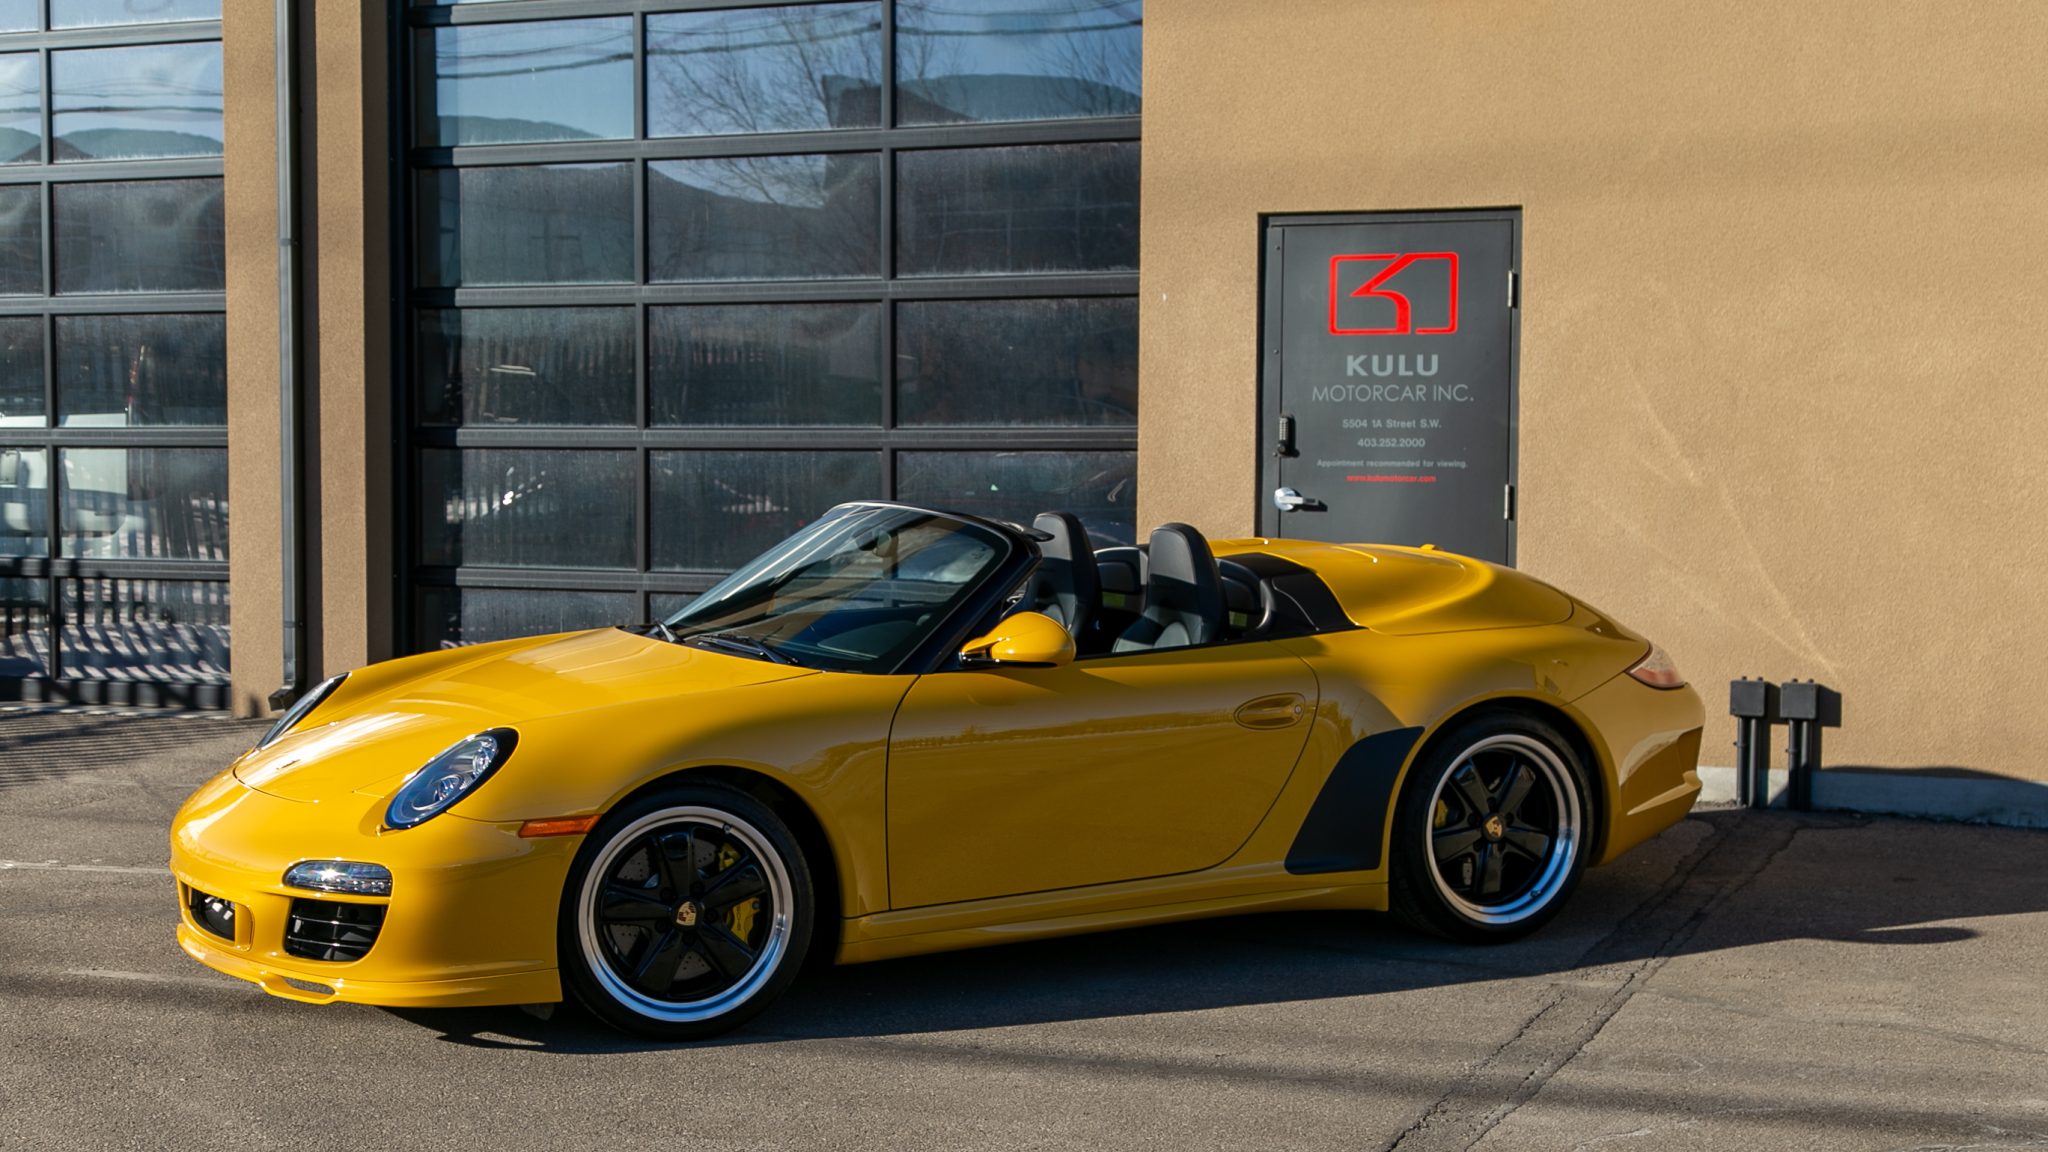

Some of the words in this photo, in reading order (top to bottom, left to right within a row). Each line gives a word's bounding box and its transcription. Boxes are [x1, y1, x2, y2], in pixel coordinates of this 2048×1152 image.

[1346, 354, 1439, 376] KULU
[1312, 384, 1426, 402] MOTORCAR
[1433, 384, 1474, 402] INC.
[1342, 418, 1367, 428] 5504
[1372, 418, 1382, 428] 1A
[1386, 418, 1416, 428] Street
[1420, 418, 1442, 428] S.W.
[1357, 438, 1426, 448] 403.252.2000
[1317, 459, 1364, 468] Appointment
[1366, 459, 1420, 467] recommended
[1423, 459, 1434, 467] for
[1437, 459, 1467, 469] viewing.
